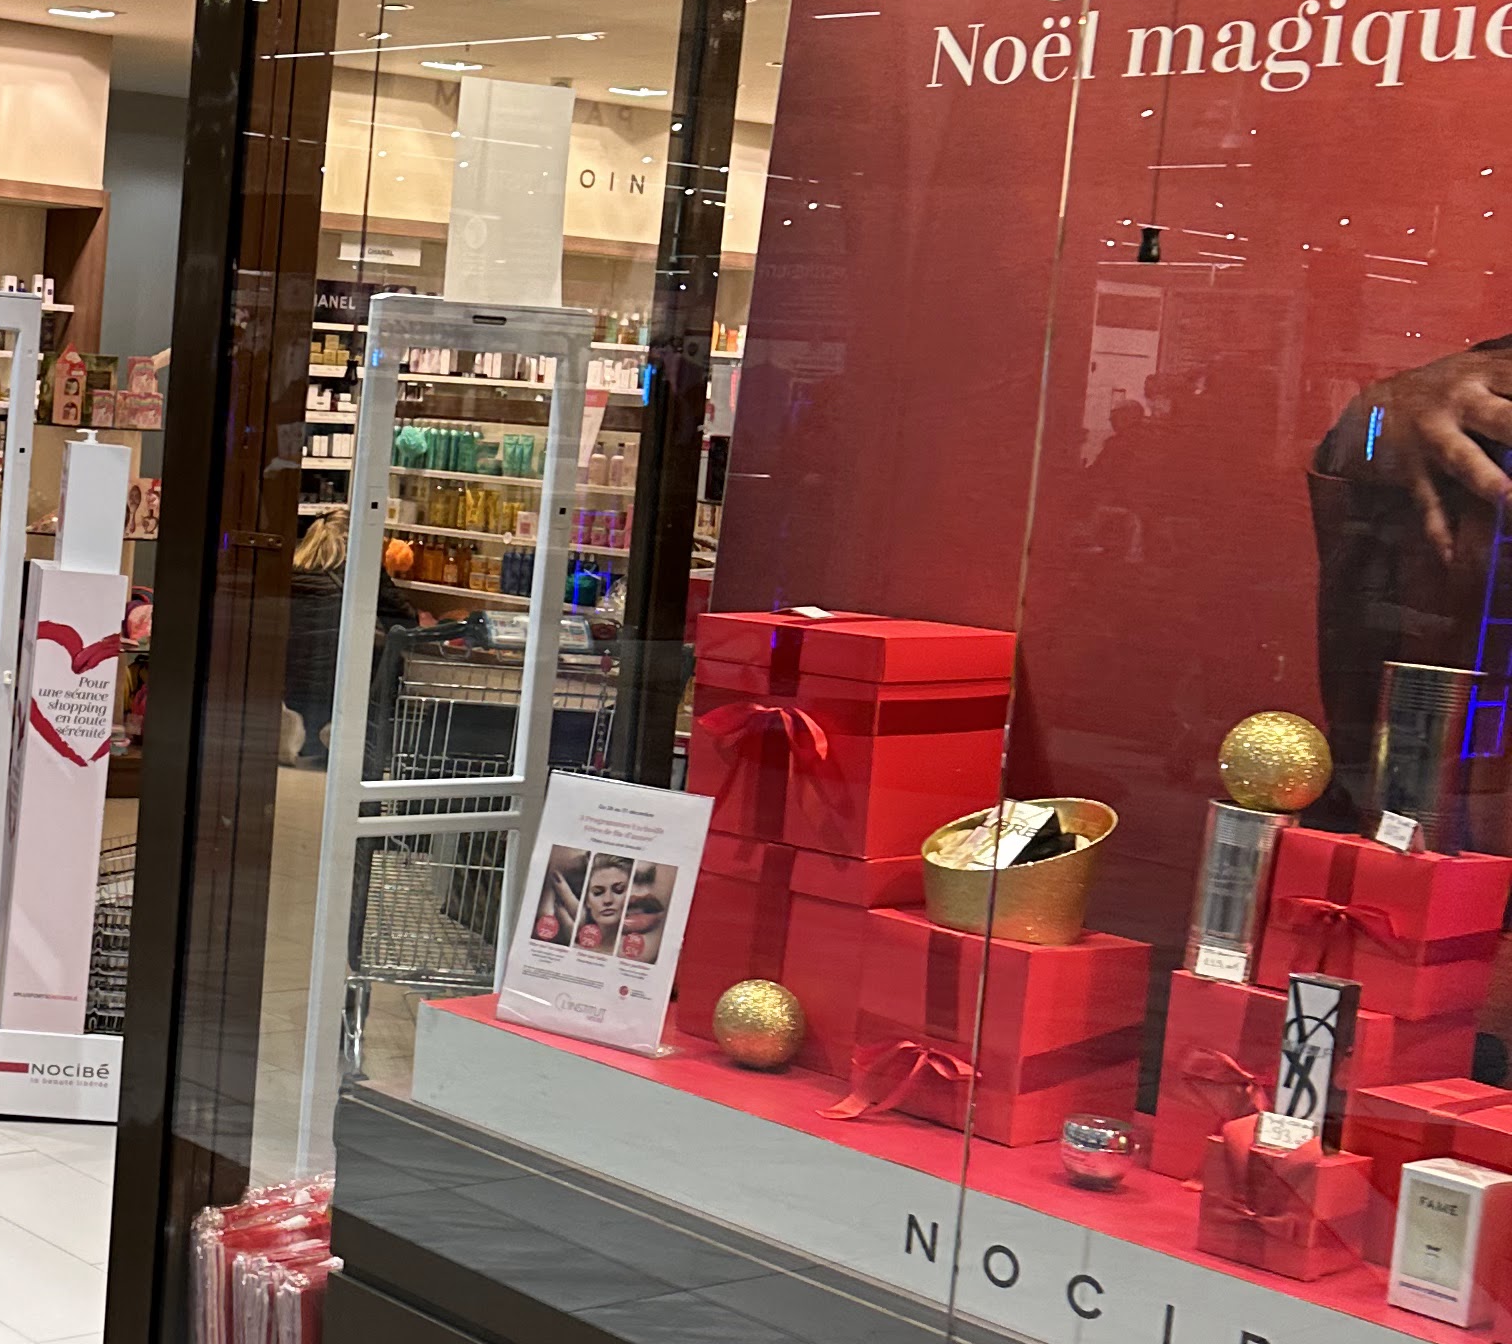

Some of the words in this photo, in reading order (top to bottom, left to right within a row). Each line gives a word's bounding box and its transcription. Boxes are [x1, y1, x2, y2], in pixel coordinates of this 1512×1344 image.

[925, 10, 1099, 89] Noël
[579, 168, 646, 195] OIN
[367, 247, 394, 257] CHANEL
[314, 293, 357, 310] ANEL
[79, 676, 110, 690] Pour
[38, 687, 64, 697] une
[64, 688, 109, 702] séance
[47, 699, 108, 717] shopping
[55, 714, 71, 723] en
[74, 714, 107, 727] toute
[55, 725, 106, 739] sérénité
[1418, 1196, 1459, 1217] FAME
